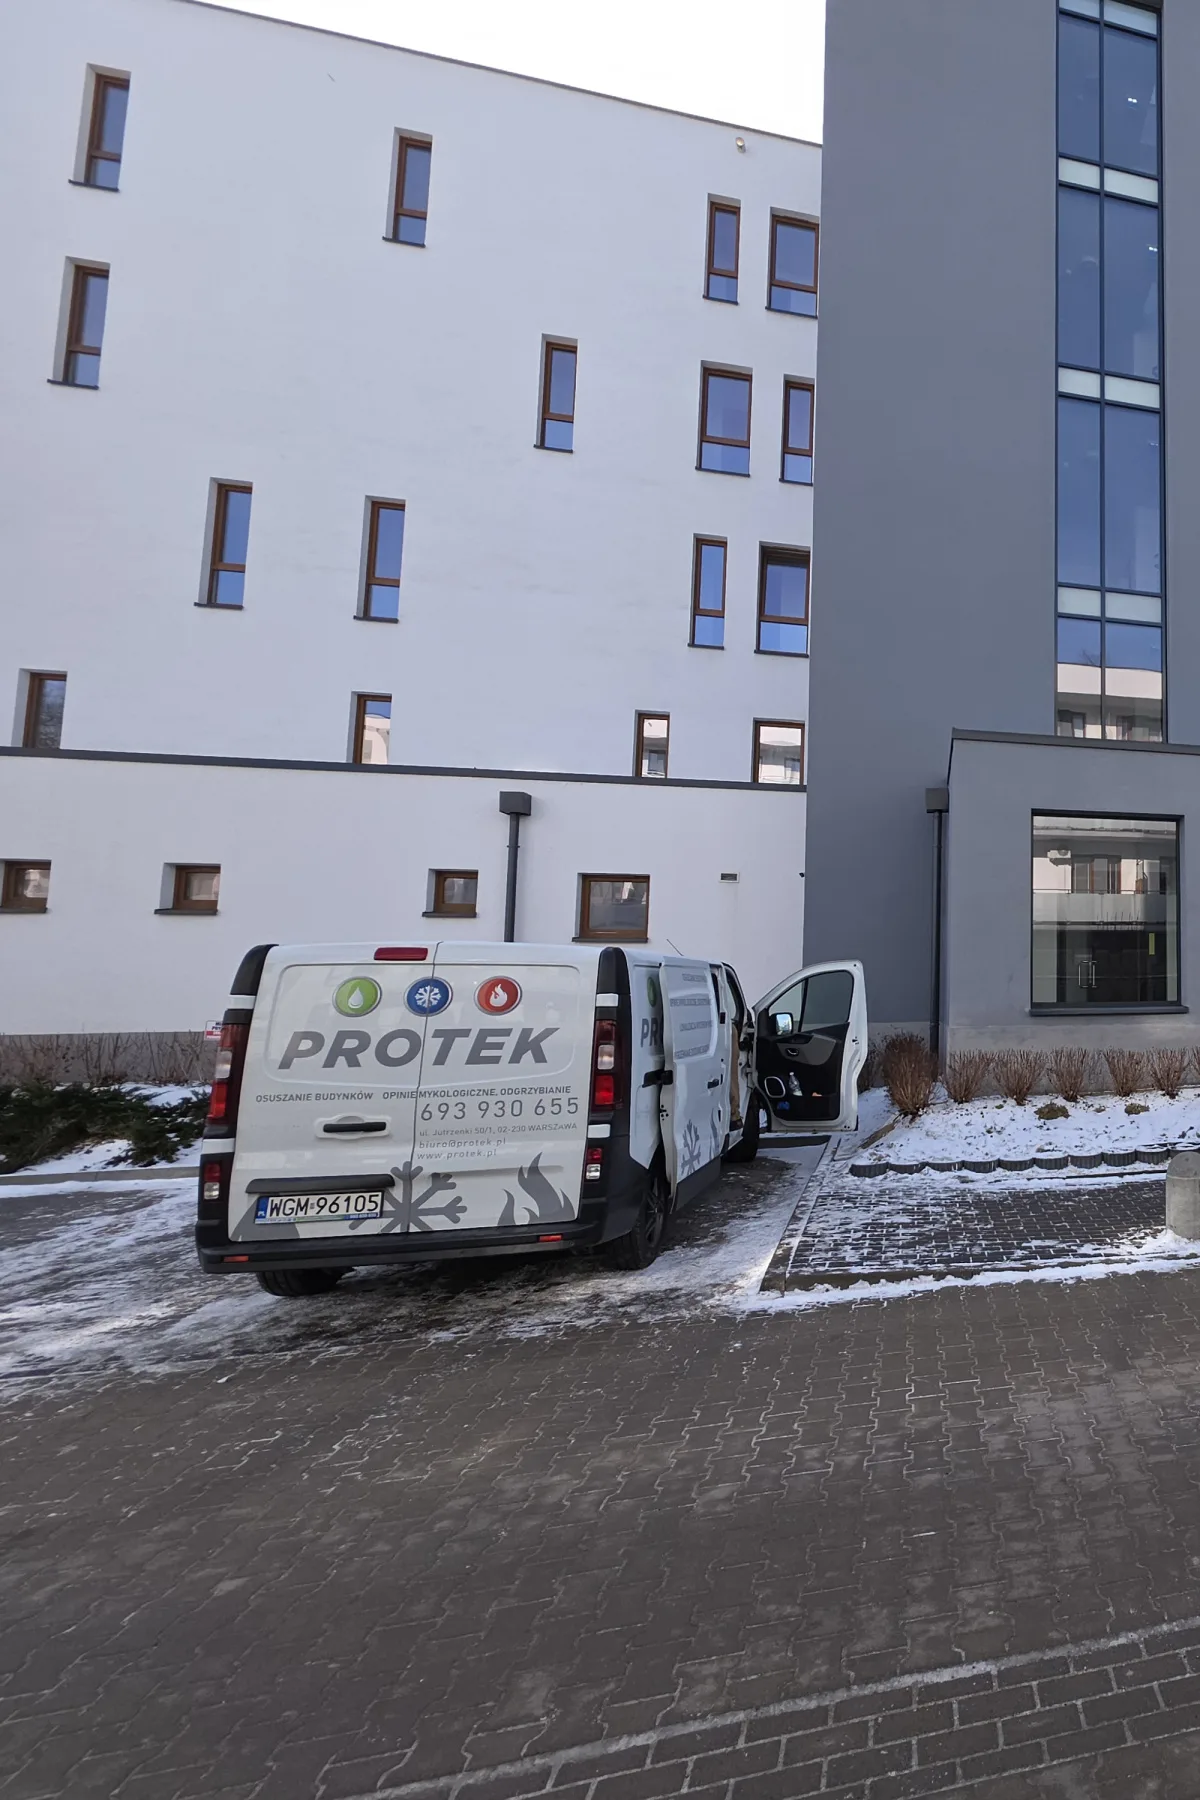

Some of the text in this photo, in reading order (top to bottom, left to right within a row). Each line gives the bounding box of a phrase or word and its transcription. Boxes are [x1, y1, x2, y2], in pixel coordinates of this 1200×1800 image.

[278, 1028, 560, 1070] PROTEK
[256, 1086, 571, 1103] OSUSZANIE BUDYNKÓW OPINIE MYKOLOGICZNE, ODGRZYBIANIE
[420, 1097, 579, 1121] 693 930 655
[432, 1127, 473, 1137] Jutrzenki
[474, 1126, 496, 1136] 50/1,
[497, 1125, 526, 1134] 02-230
[527, 1122, 577, 1132] WARSZAWA
[419, 1137, 506, 1149] biuro@protek.pl
[417, 1149, 498, 1161] www.protek.pl
[269, 1194, 380, 1217] WGM 96105
